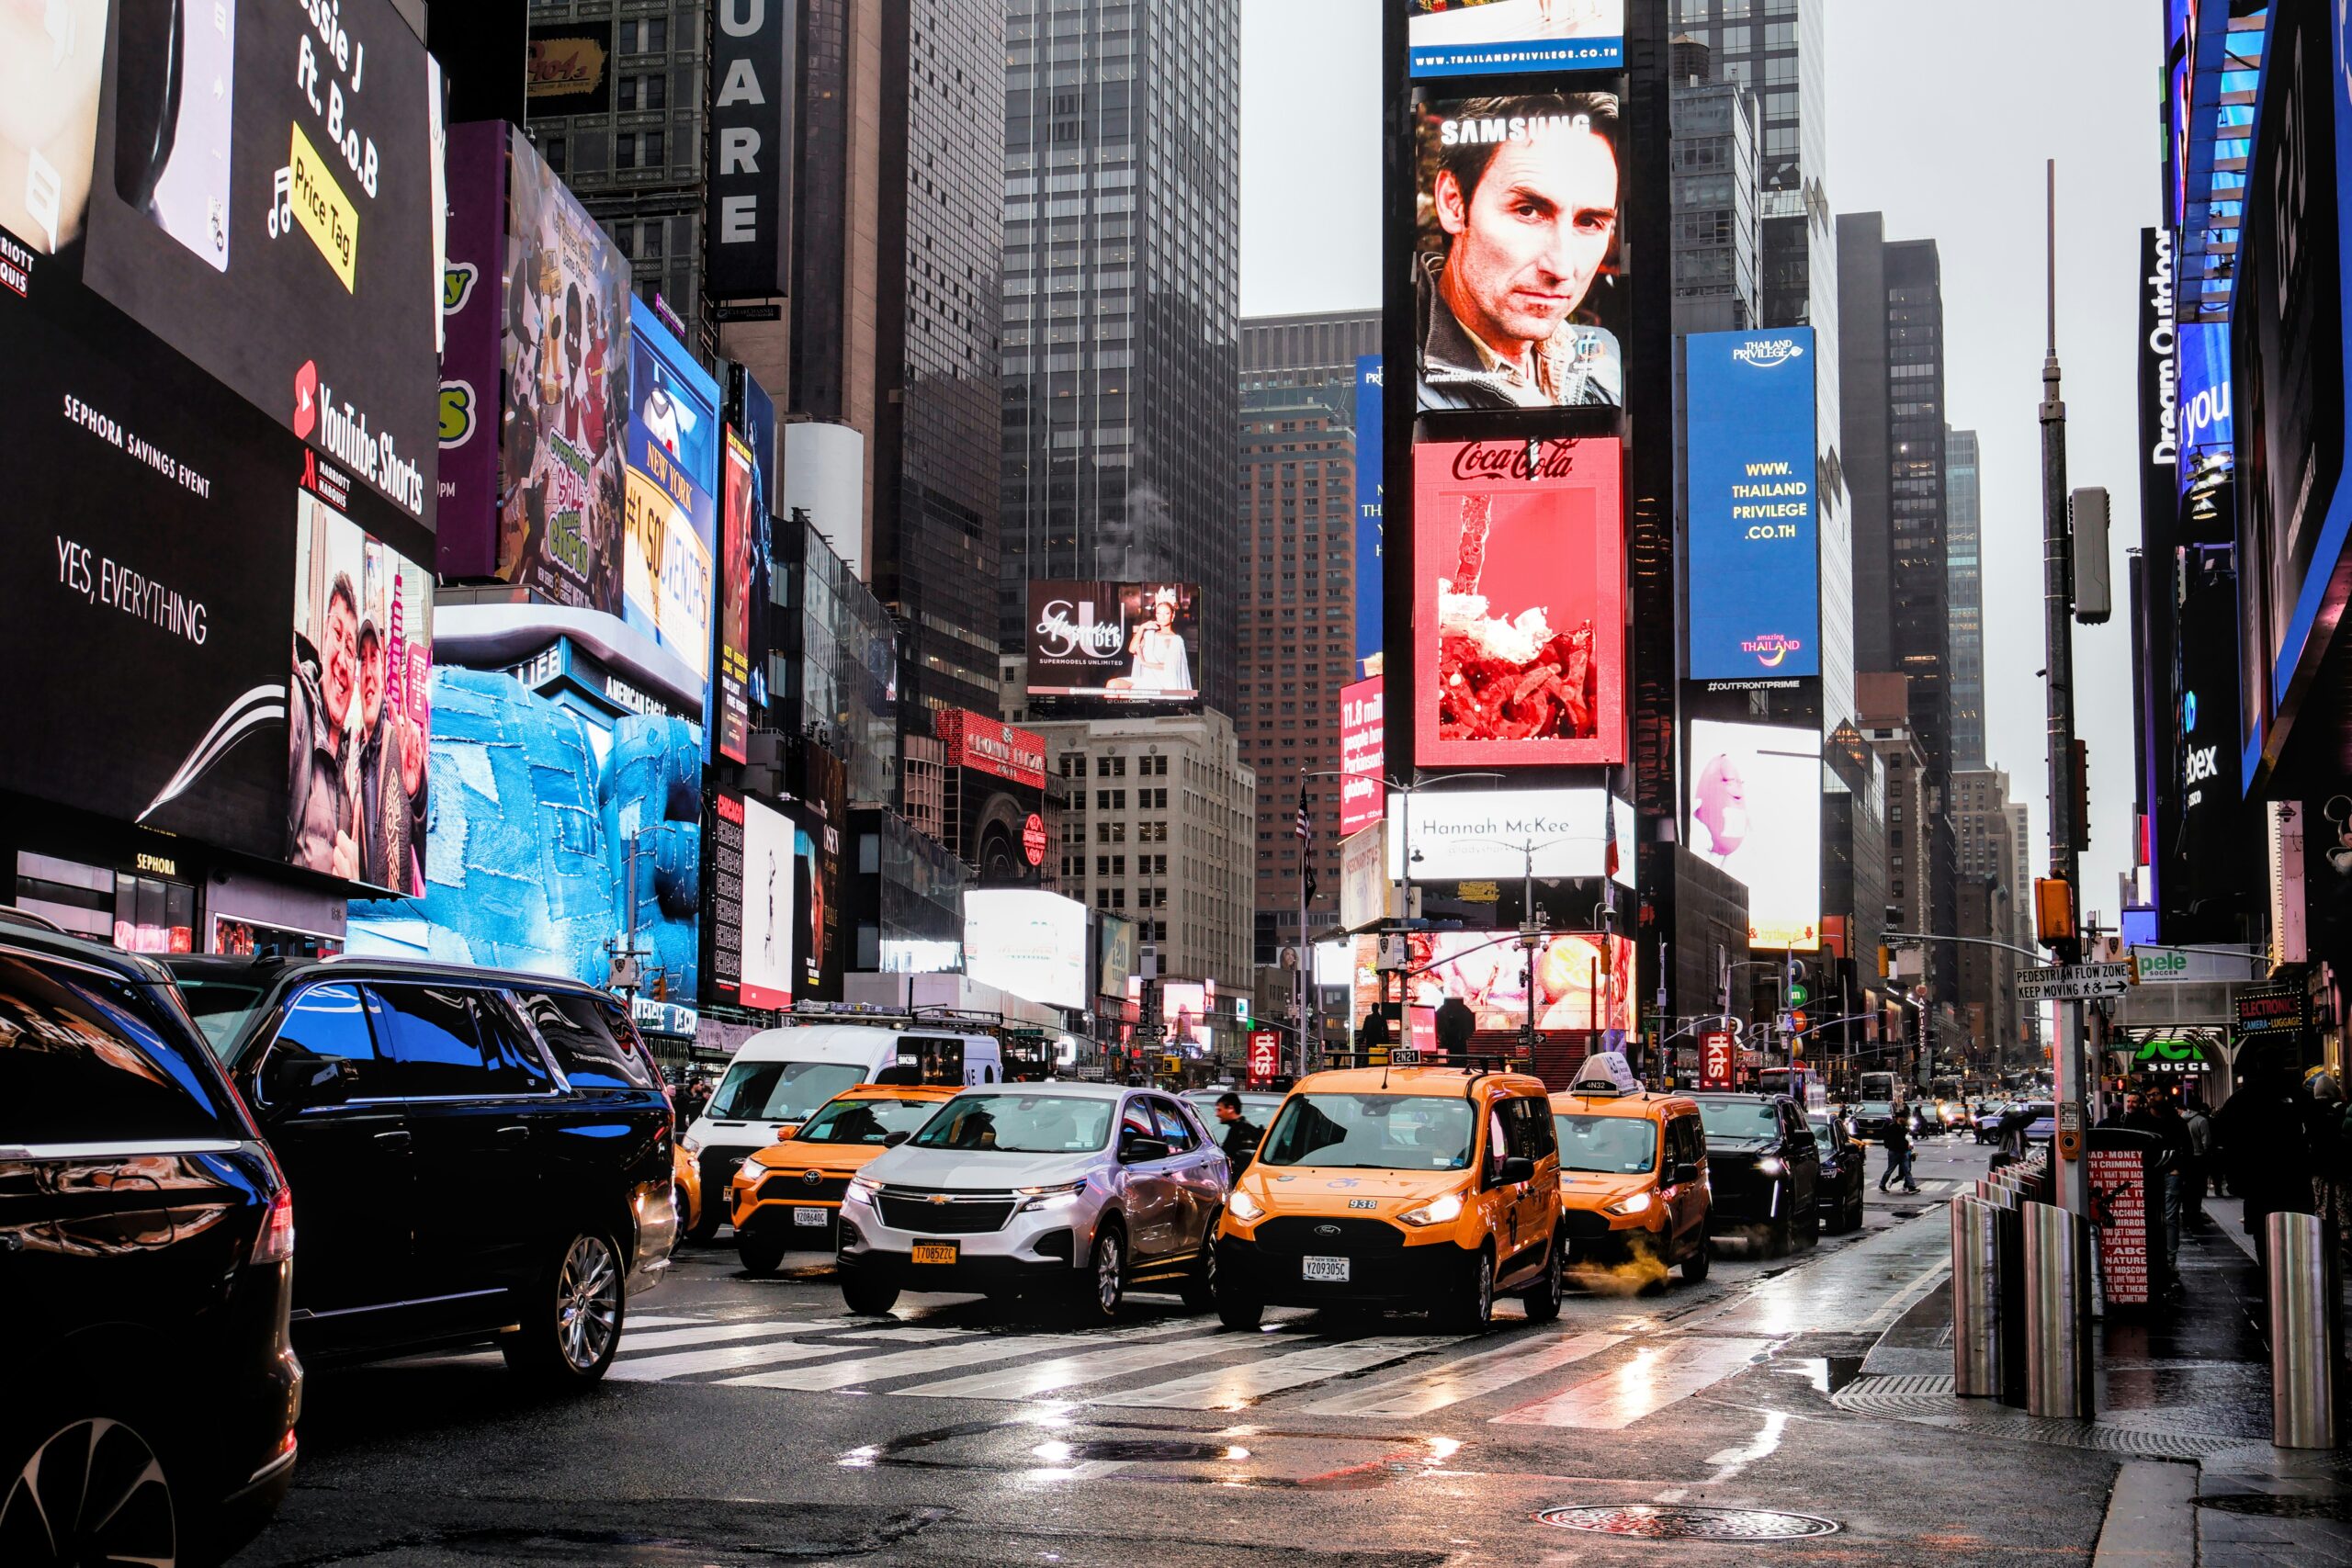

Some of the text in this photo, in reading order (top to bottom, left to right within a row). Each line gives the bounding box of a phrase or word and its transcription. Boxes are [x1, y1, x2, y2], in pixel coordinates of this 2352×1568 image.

[300, 0, 363, 93] ssie J
[1416, 48, 1617, 67] WWW.THAILANDPRIVILEGE.CO.TH
[297, 34, 379, 198] ft. B.o.B
[1441, 114, 1590, 145] SAMSUNG
[295, 156, 351, 268] Price Tag
[0, 235, 34, 272] RIOTT
[1734, 348, 1788, 359] PRIVILEGE
[1745, 339, 1792, 350] THAILAND
[2148, 225, 2177, 464] Dream Outdoor
[2188, 381, 2229, 448] you
[63, 394, 210, 500] SEPHORA SAVINGS EVENT
[320, 382, 378, 481] YouTube
[379, 431, 424, 515] Shorts
[1452, 439, 1580, 480] Coca-Cola
[319, 461, 350, 492] MARRIOTT
[647, 441, 693, 513] NEW YORK
[1746, 462, 1792, 477] WWW.
[318, 479, 346, 508] MARQUIS
[1732, 481, 1806, 498] THAILAND
[1733, 503, 1807, 519] PRIVILEGE
[1745, 525, 1796, 539] .CO.TH
[57, 536, 207, 645] YES, EVERYTHING
[1072, 633, 1121, 648] PINDER
[1740, 640, 1800, 652] THAILAND
[1039, 658, 1086, 666] SUPERMODELS
[606, 675, 644, 715] AMERICAN
[1707, 680, 1801, 692] #OUTFRONTPRIME
[1343, 698, 1362, 728] 11.8
[1344, 728, 1369, 756] people
[1344, 778, 1374, 804] globally.
[718, 795, 742, 825] CHICAGO
[717, 819, 742, 851] CHICAGO
[1423, 817, 1569, 835] Hannah McKee
[137, 852, 175, 876] SEPHORA
[717, 845, 742, 876] CHICAGO
[716, 872, 742, 902] CHICAGO
[716, 898, 742, 927] CHICAGO
[715, 924, 741, 953] CHICAGO
[715, 949, 741, 978] CHICAGO
[2017, 964, 2127, 983] PEDESTRIAN FLOW ZONE
[2018, 984, 2078, 998] KEEP MOVING
[2242, 998, 2298, 1017] ELECTRONICS
[2243, 1017, 2300, 1030] CAMERA LUGGAGE
[1255, 1034, 1275, 1076] tkts
[1396, 1053, 1416, 1062] 2N21
[1708, 1034, 1729, 1078] tkts
[1350, 1200, 1376, 1209] 938
[2115, 1200, 2145, 1208] ABOUT US
[916, 1247, 953, 1259] T708522C
[2105, 1257, 2147, 1265] NATURE
[2113, 1247, 2146, 1255] ABC
[1306, 1262, 1345, 1276] Y209305C
